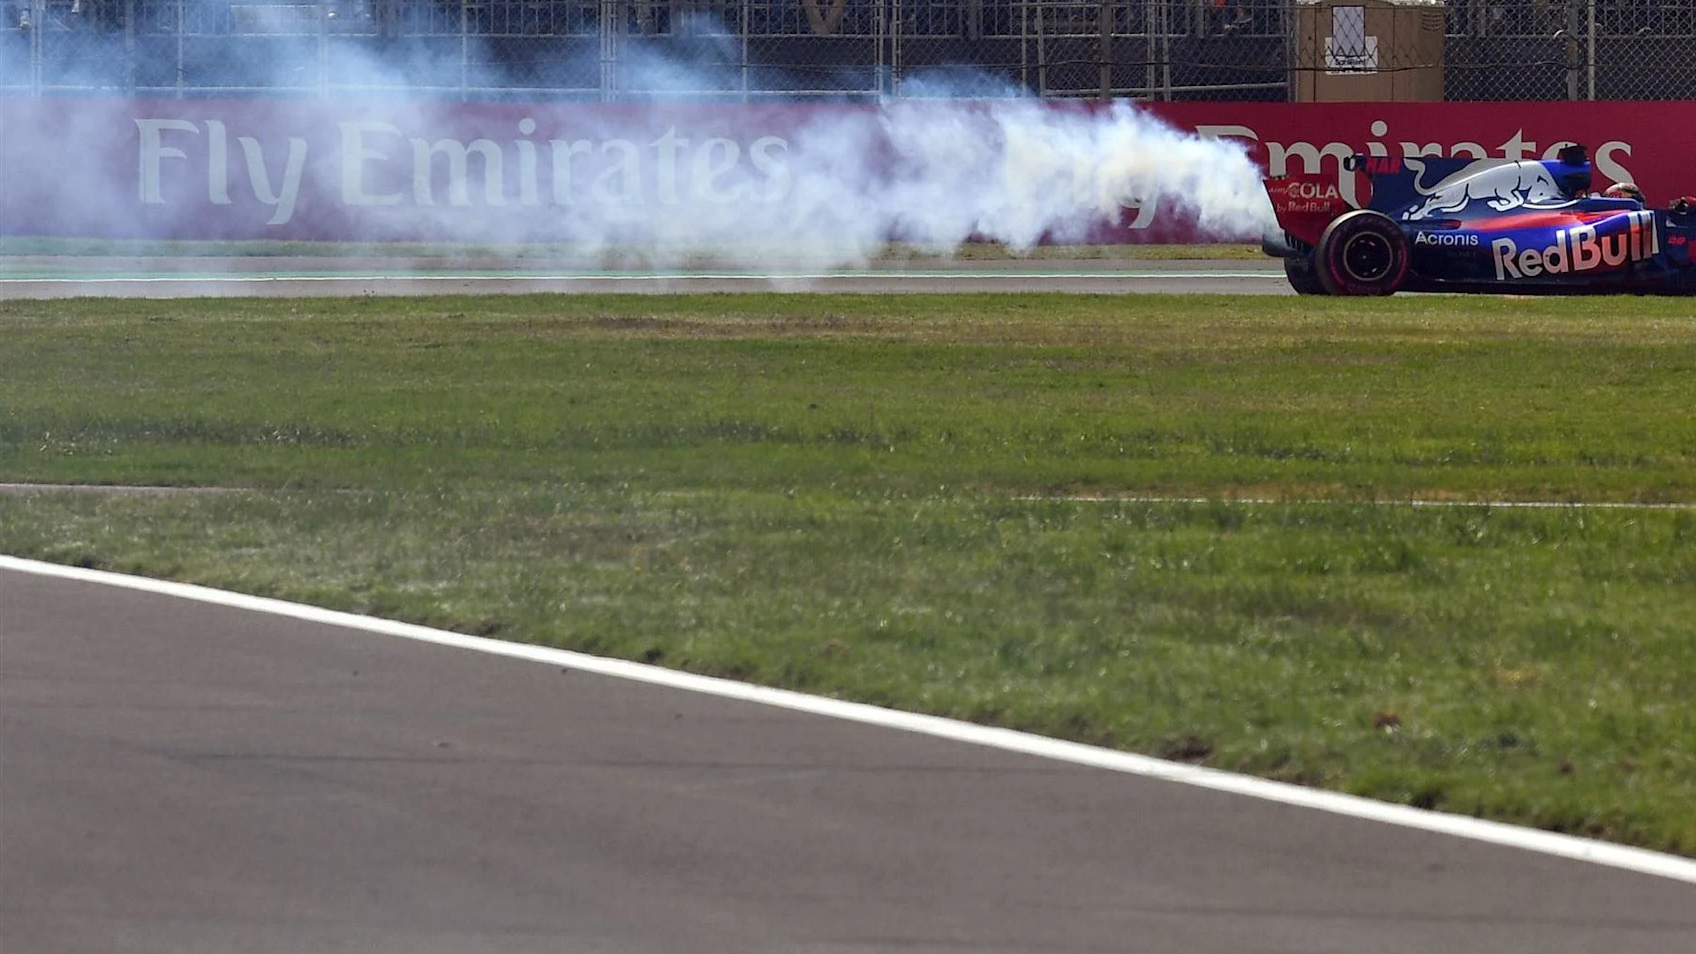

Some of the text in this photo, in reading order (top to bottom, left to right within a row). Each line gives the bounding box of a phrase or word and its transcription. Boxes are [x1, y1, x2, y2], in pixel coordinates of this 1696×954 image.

[134, 117, 792, 226] Fly Emirates
[1288, 182, 1338, 199] COLA
[1414, 231, 1479, 246] Acronis
